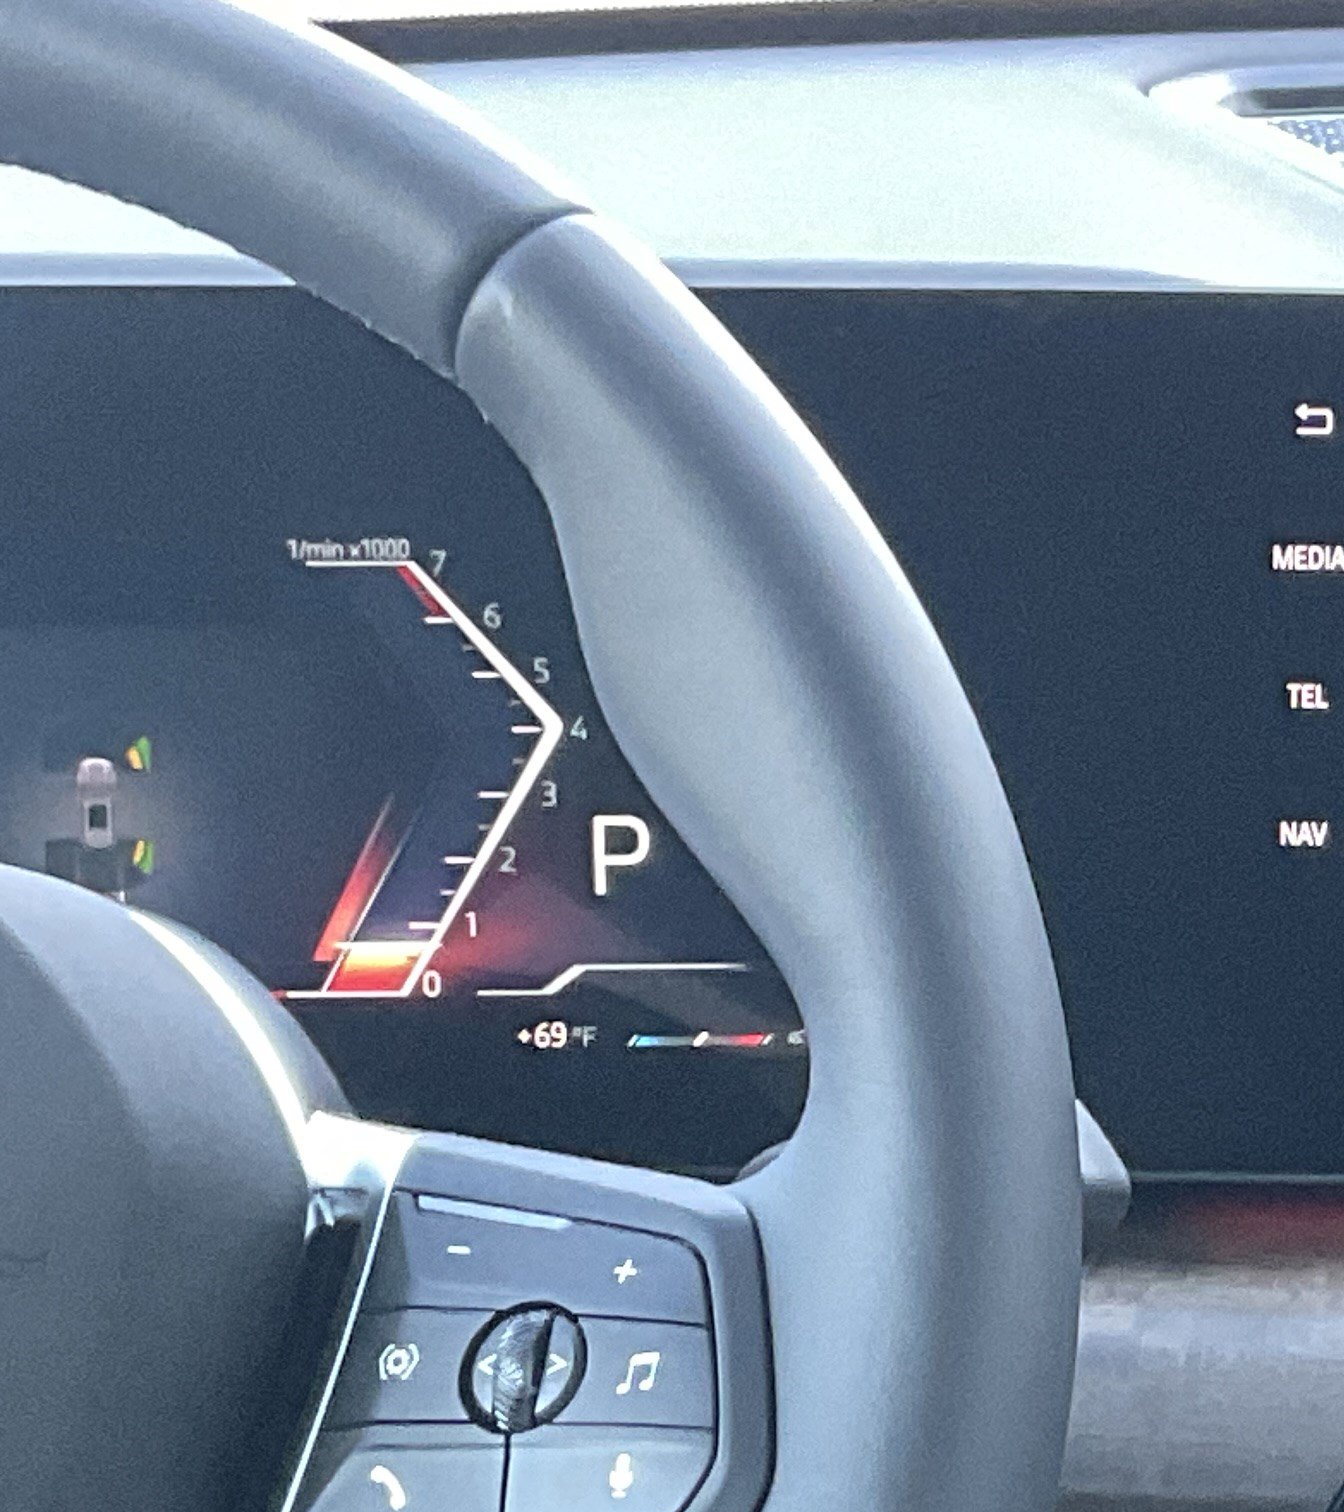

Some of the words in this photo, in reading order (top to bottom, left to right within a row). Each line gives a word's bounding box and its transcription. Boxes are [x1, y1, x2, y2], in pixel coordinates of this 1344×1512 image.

[286, 538, 344, 560] 1/min
[349, 537, 410, 560] x1000
[429, 549, 447, 577] 7
[483, 604, 502, 629] 6
[533, 657, 551, 684] 5
[1286, 682, 1330, 710] TEL
[571, 717, 589, 742] 4
[541, 781, 558, 808] 3
[1279, 821, 1328, 848] NAV
[499, 847, 517, 874] 2
[592, 814, 651, 897] P
[464, 912, 478, 939] 1
[423, 972, 441, 1000] 0
